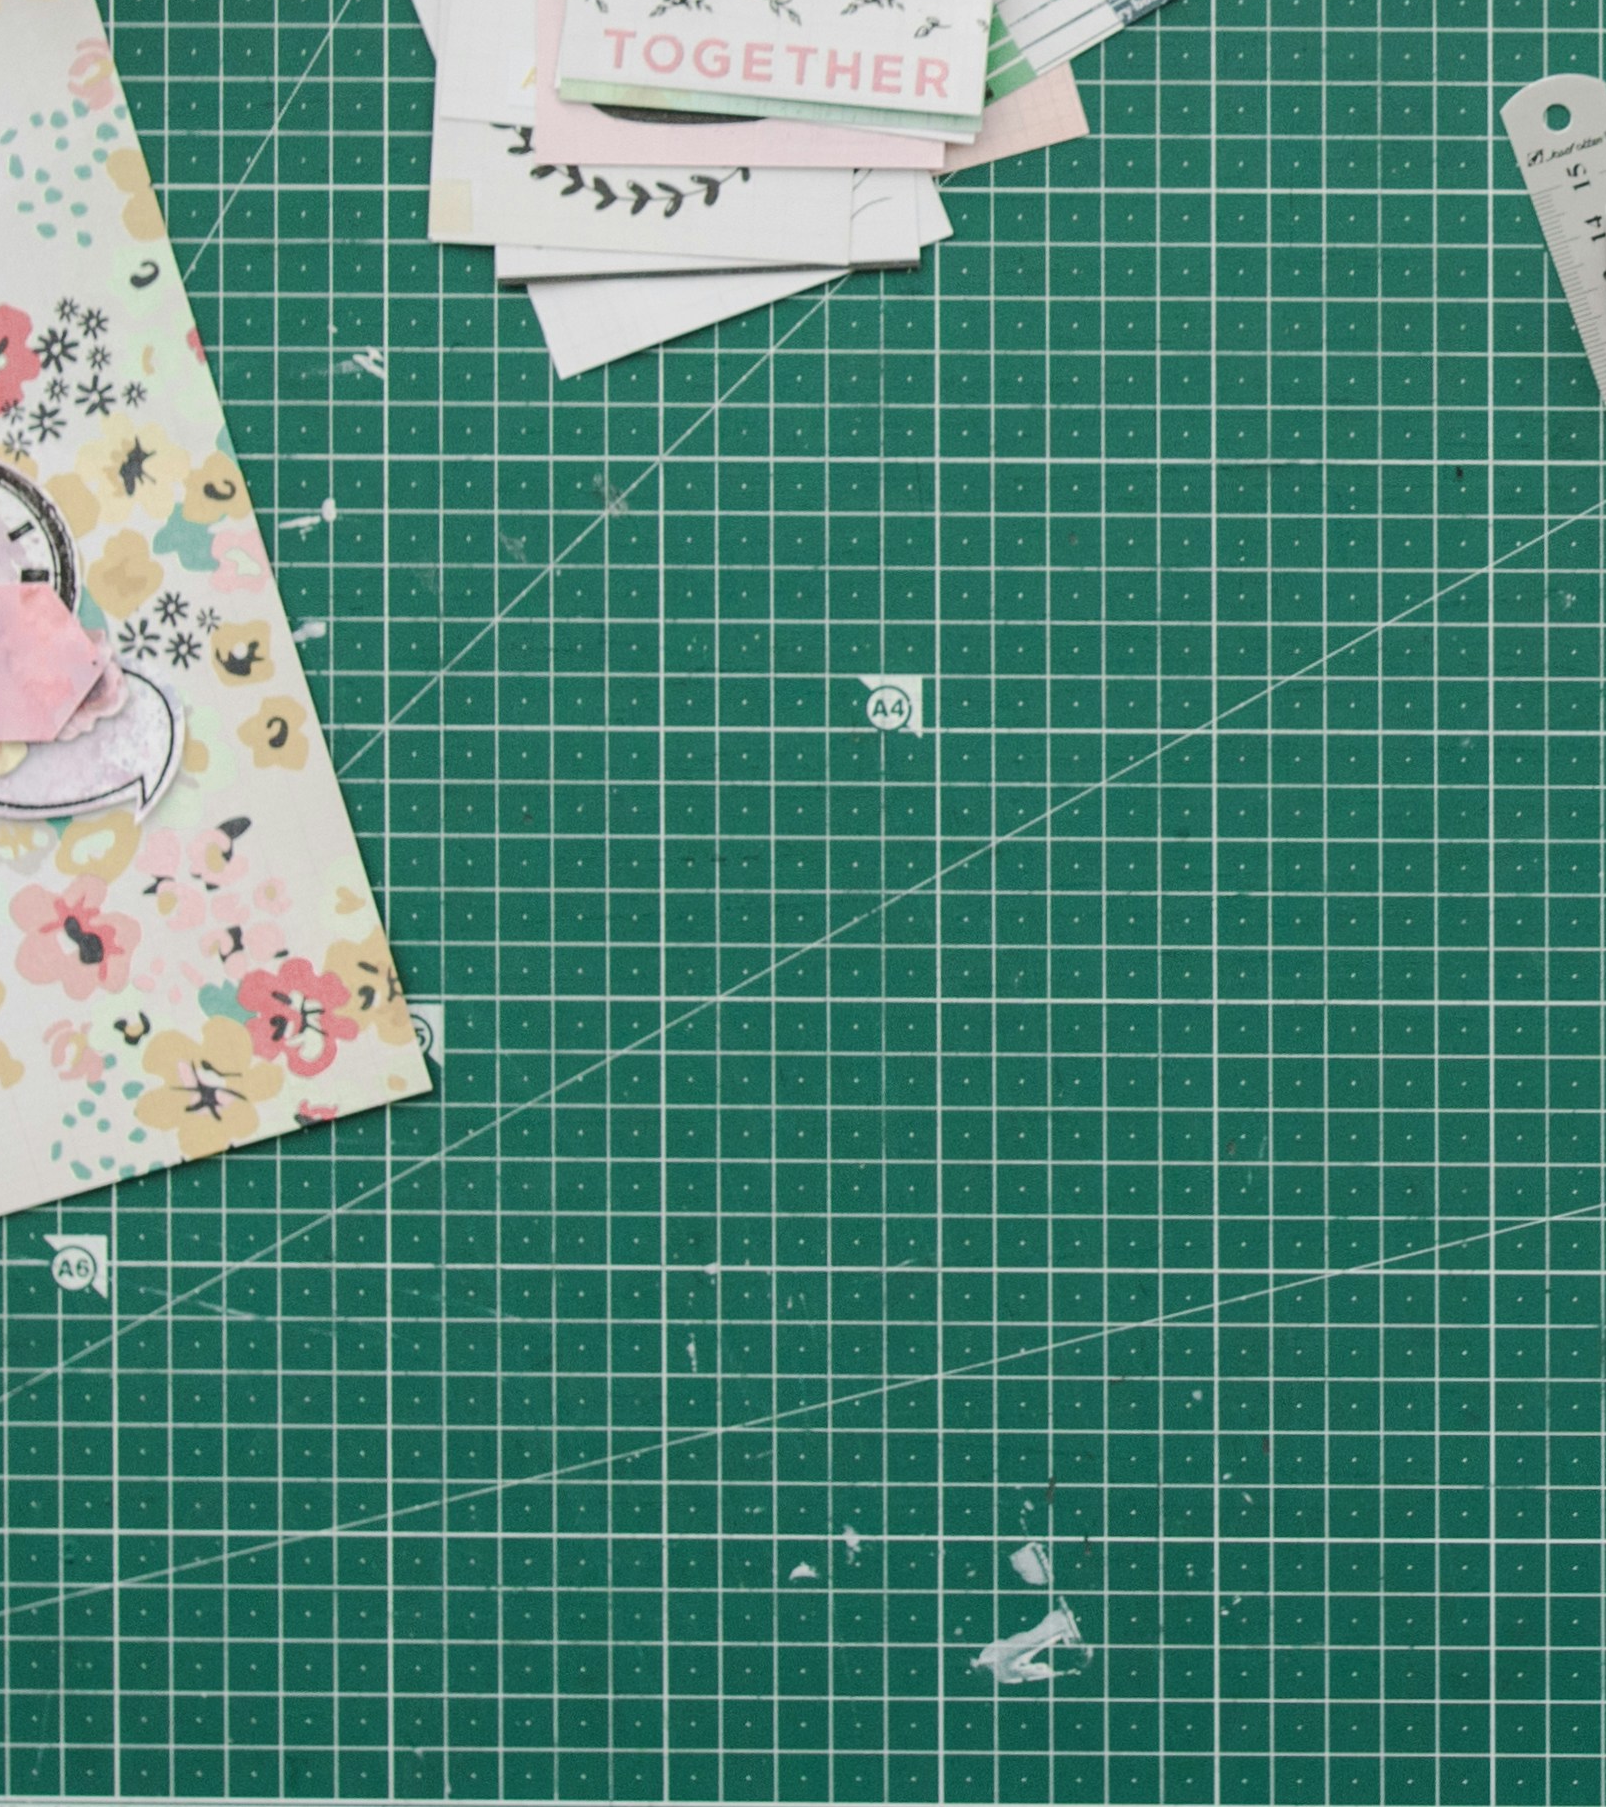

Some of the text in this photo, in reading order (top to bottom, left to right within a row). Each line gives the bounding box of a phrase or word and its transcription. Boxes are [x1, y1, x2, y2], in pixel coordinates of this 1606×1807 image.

[603, 28, 951, 100] TOGETHER
[1566, 163, 1591, 191] 15
[871, 698, 907, 720] A4
[58, 1260, 90, 1278] A6
